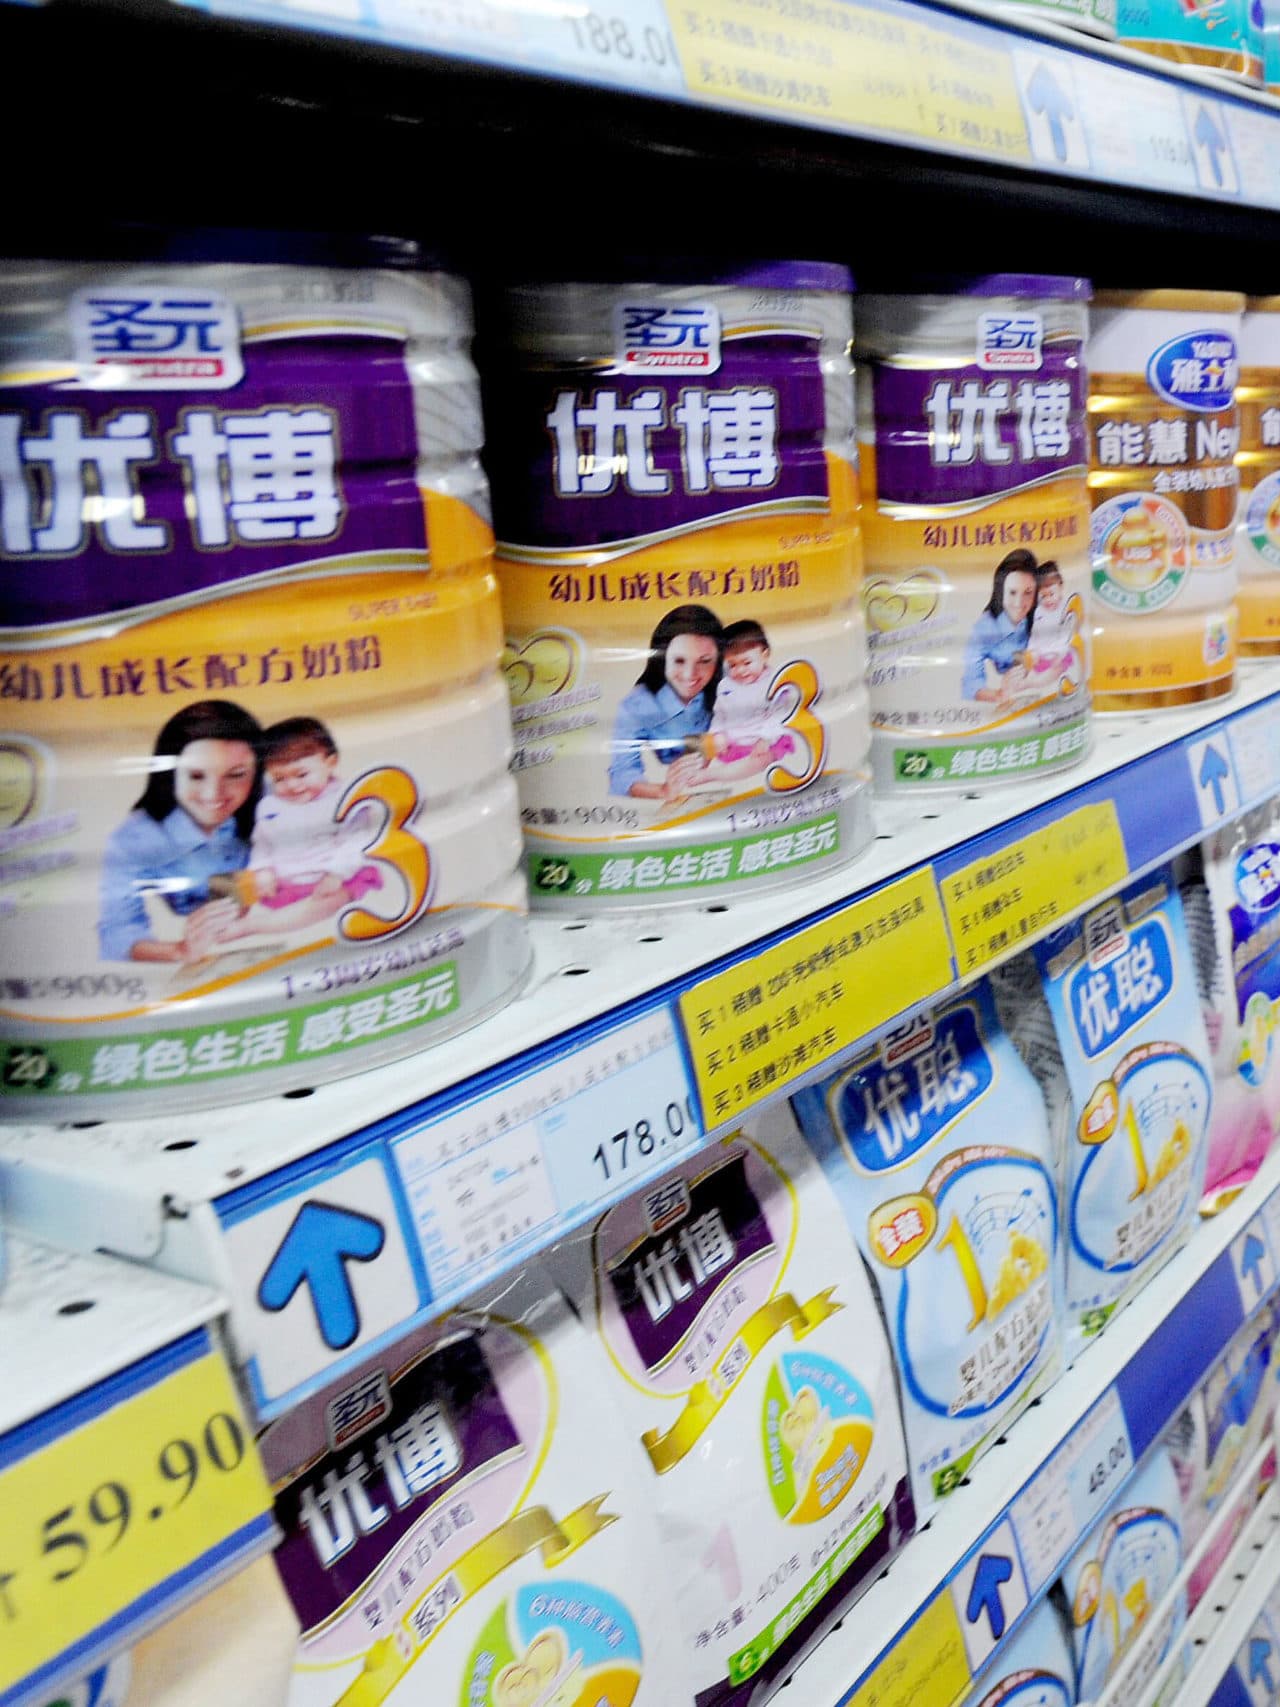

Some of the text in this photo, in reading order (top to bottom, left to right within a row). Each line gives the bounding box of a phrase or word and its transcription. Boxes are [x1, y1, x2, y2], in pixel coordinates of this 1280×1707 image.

[87, 299, 223, 353] 圣元
[624, 306, 710, 348] 圣元
[985, 319, 1037, 350] 圣元
[547, 389, 778, 494] 优博
[926, 381, 1071, 463] 优博
[1097, 419, 1188, 465] 能慧
[0, 409, 341, 553] 优博
[549, 559, 800, 603] 幼儿成长配方奶粉
[767, 659, 829, 797] 3
[335, 765, 433, 943] 3
[600, 845, 733, 891] 绿色生活
[740, 818, 838, 873] 感受圣元
[90, 1020, 290, 1086] 绿色生活
[299, 970, 456, 1053] 感受圣元
[1079, 937, 1163, 1051] 优聪
[863, 1030, 978, 1161] 优聪
[633, 1206, 737, 1325] 优博
[41, 1412, 246, 1584] 59.90
[300, 1400, 463, 1570] 优博
